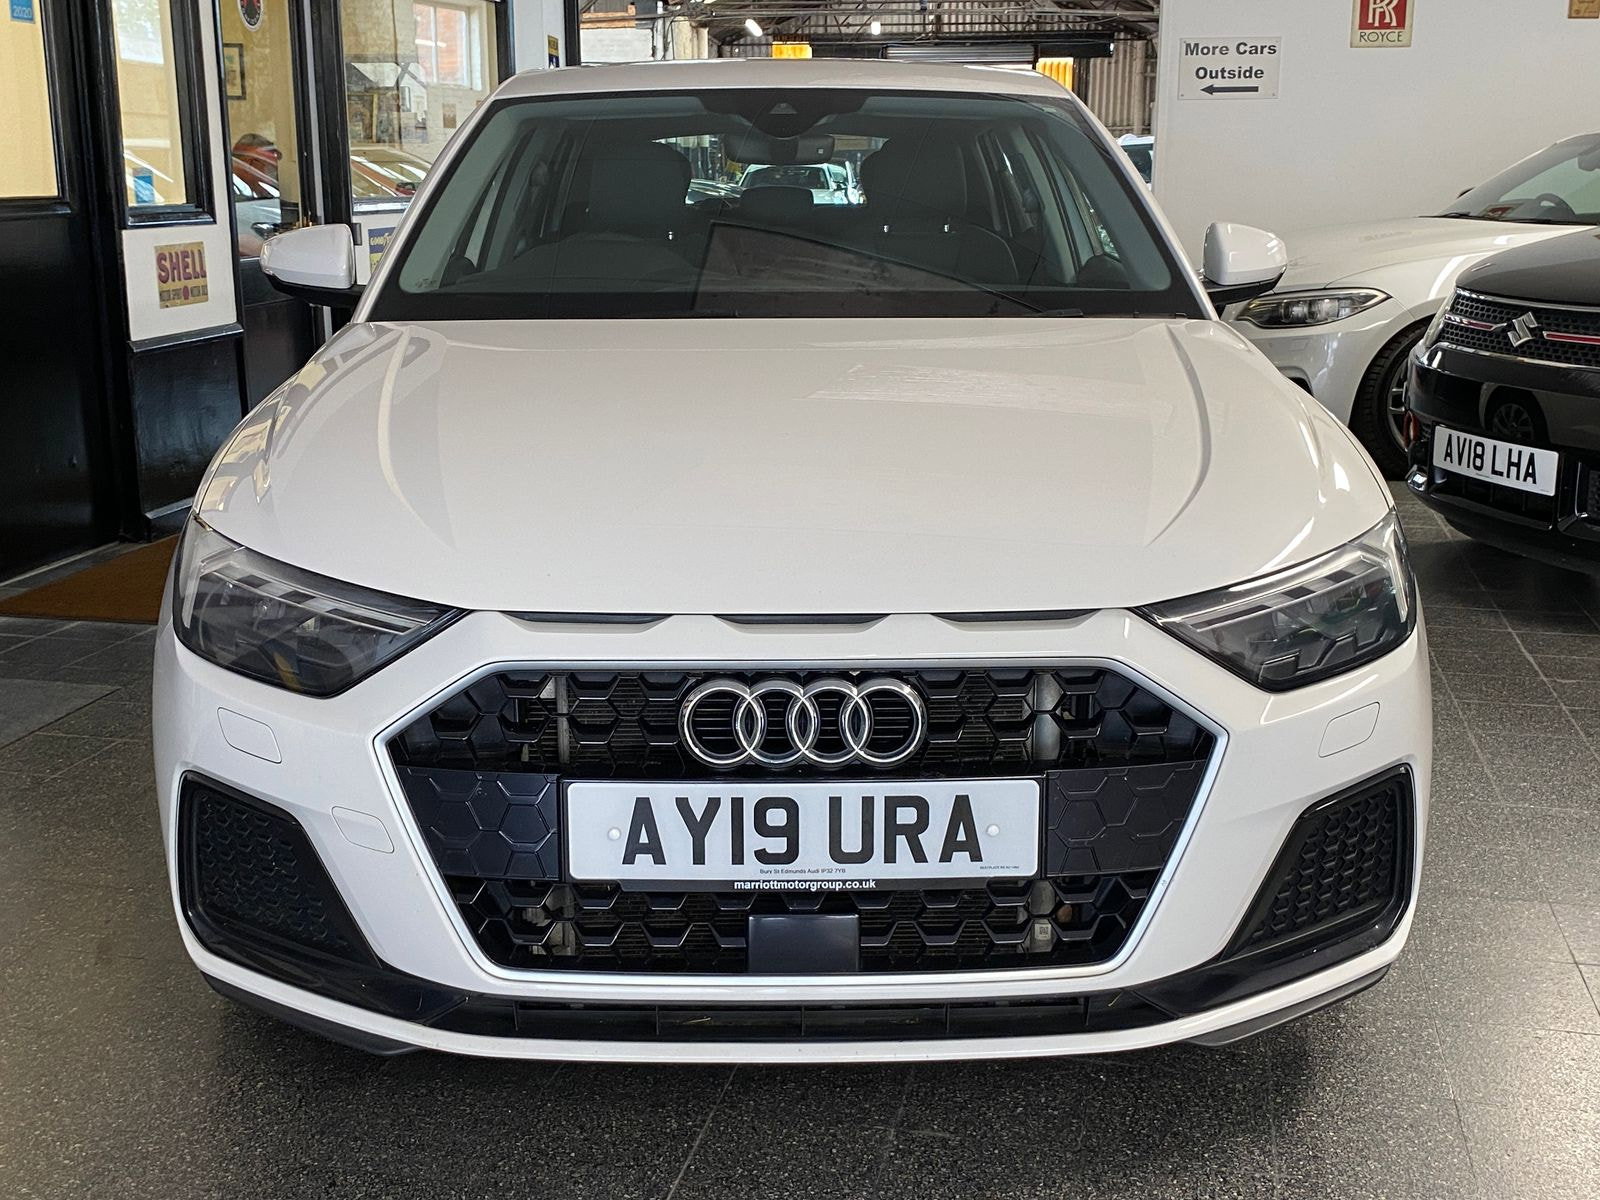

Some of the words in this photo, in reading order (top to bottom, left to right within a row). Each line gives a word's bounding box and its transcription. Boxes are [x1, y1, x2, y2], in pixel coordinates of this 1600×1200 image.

[1359, 31, 1403, 43] ROYCE
[1184, 42, 1229, 56] More
[1235, 42, 1277, 55] Cars
[1195, 66, 1264, 80] Outside
[156, 249, 207, 284] SHELL
[1443, 433, 1486, 472] AV18
[1491, 445, 1537, 485] LHA
[621, 796, 800, 866] AY19
[829, 794, 983, 865] URA
[734, 879, 876, 892] marriottmotorgroup.co.uk
